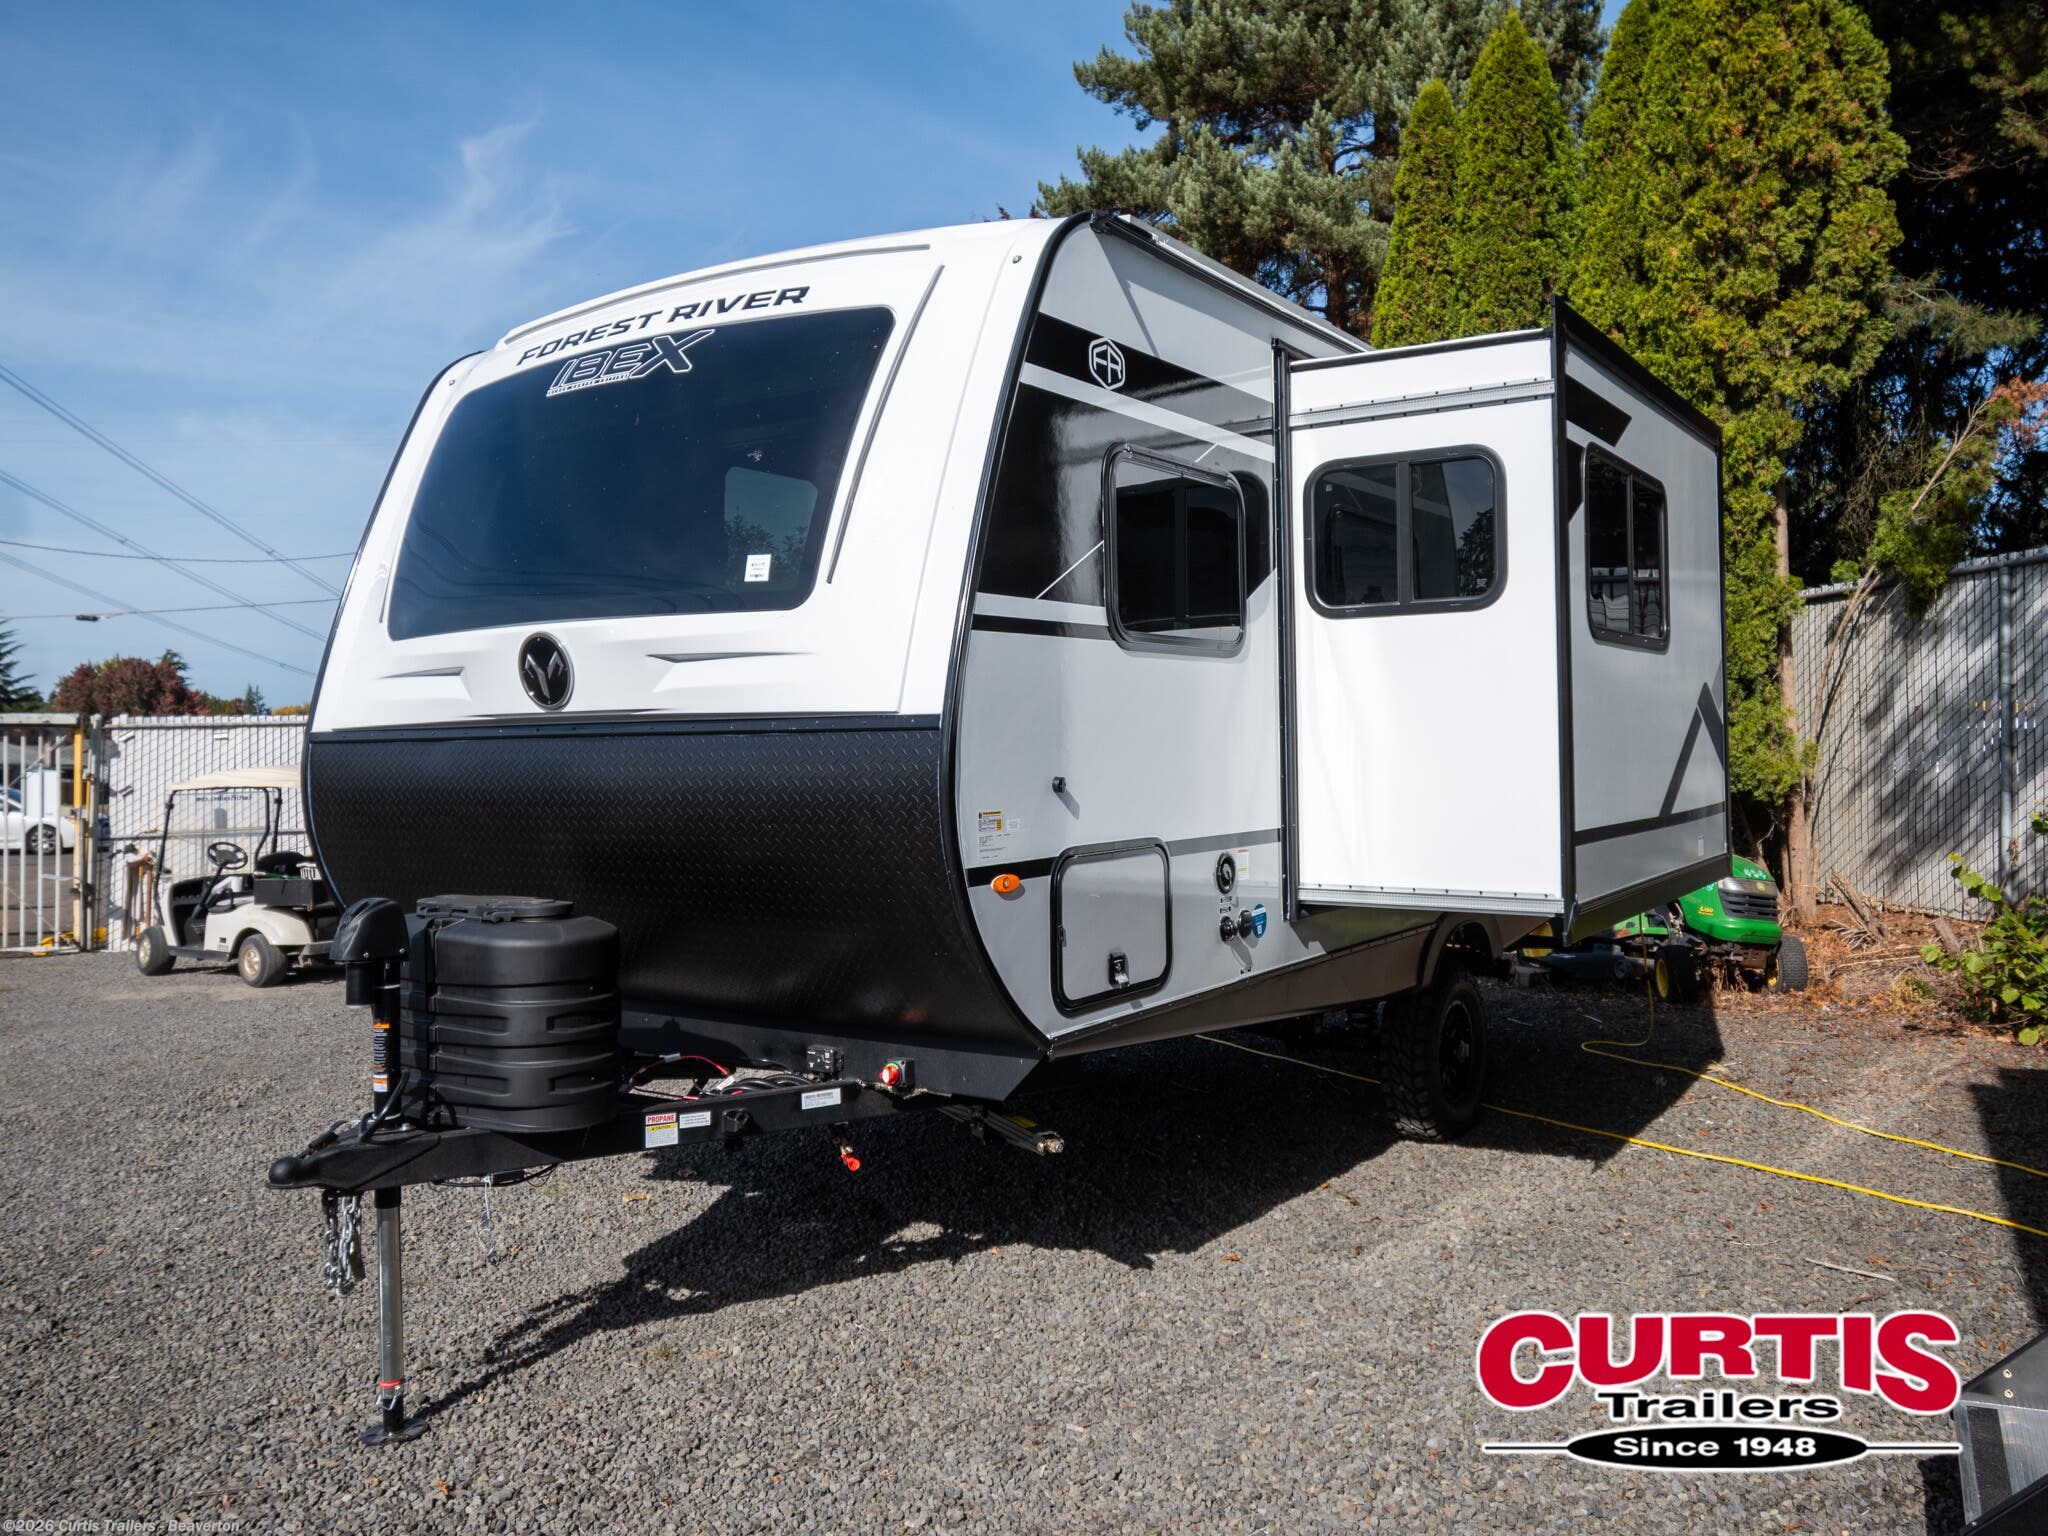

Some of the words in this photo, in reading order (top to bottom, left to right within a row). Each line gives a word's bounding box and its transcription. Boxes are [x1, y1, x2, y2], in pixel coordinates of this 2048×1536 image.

[516, 310, 663, 366] FOREST
[667, 285, 811, 323] RIVER
[548, 328, 716, 390] IBEX
[647, 1114, 675, 1124] PROPANE
